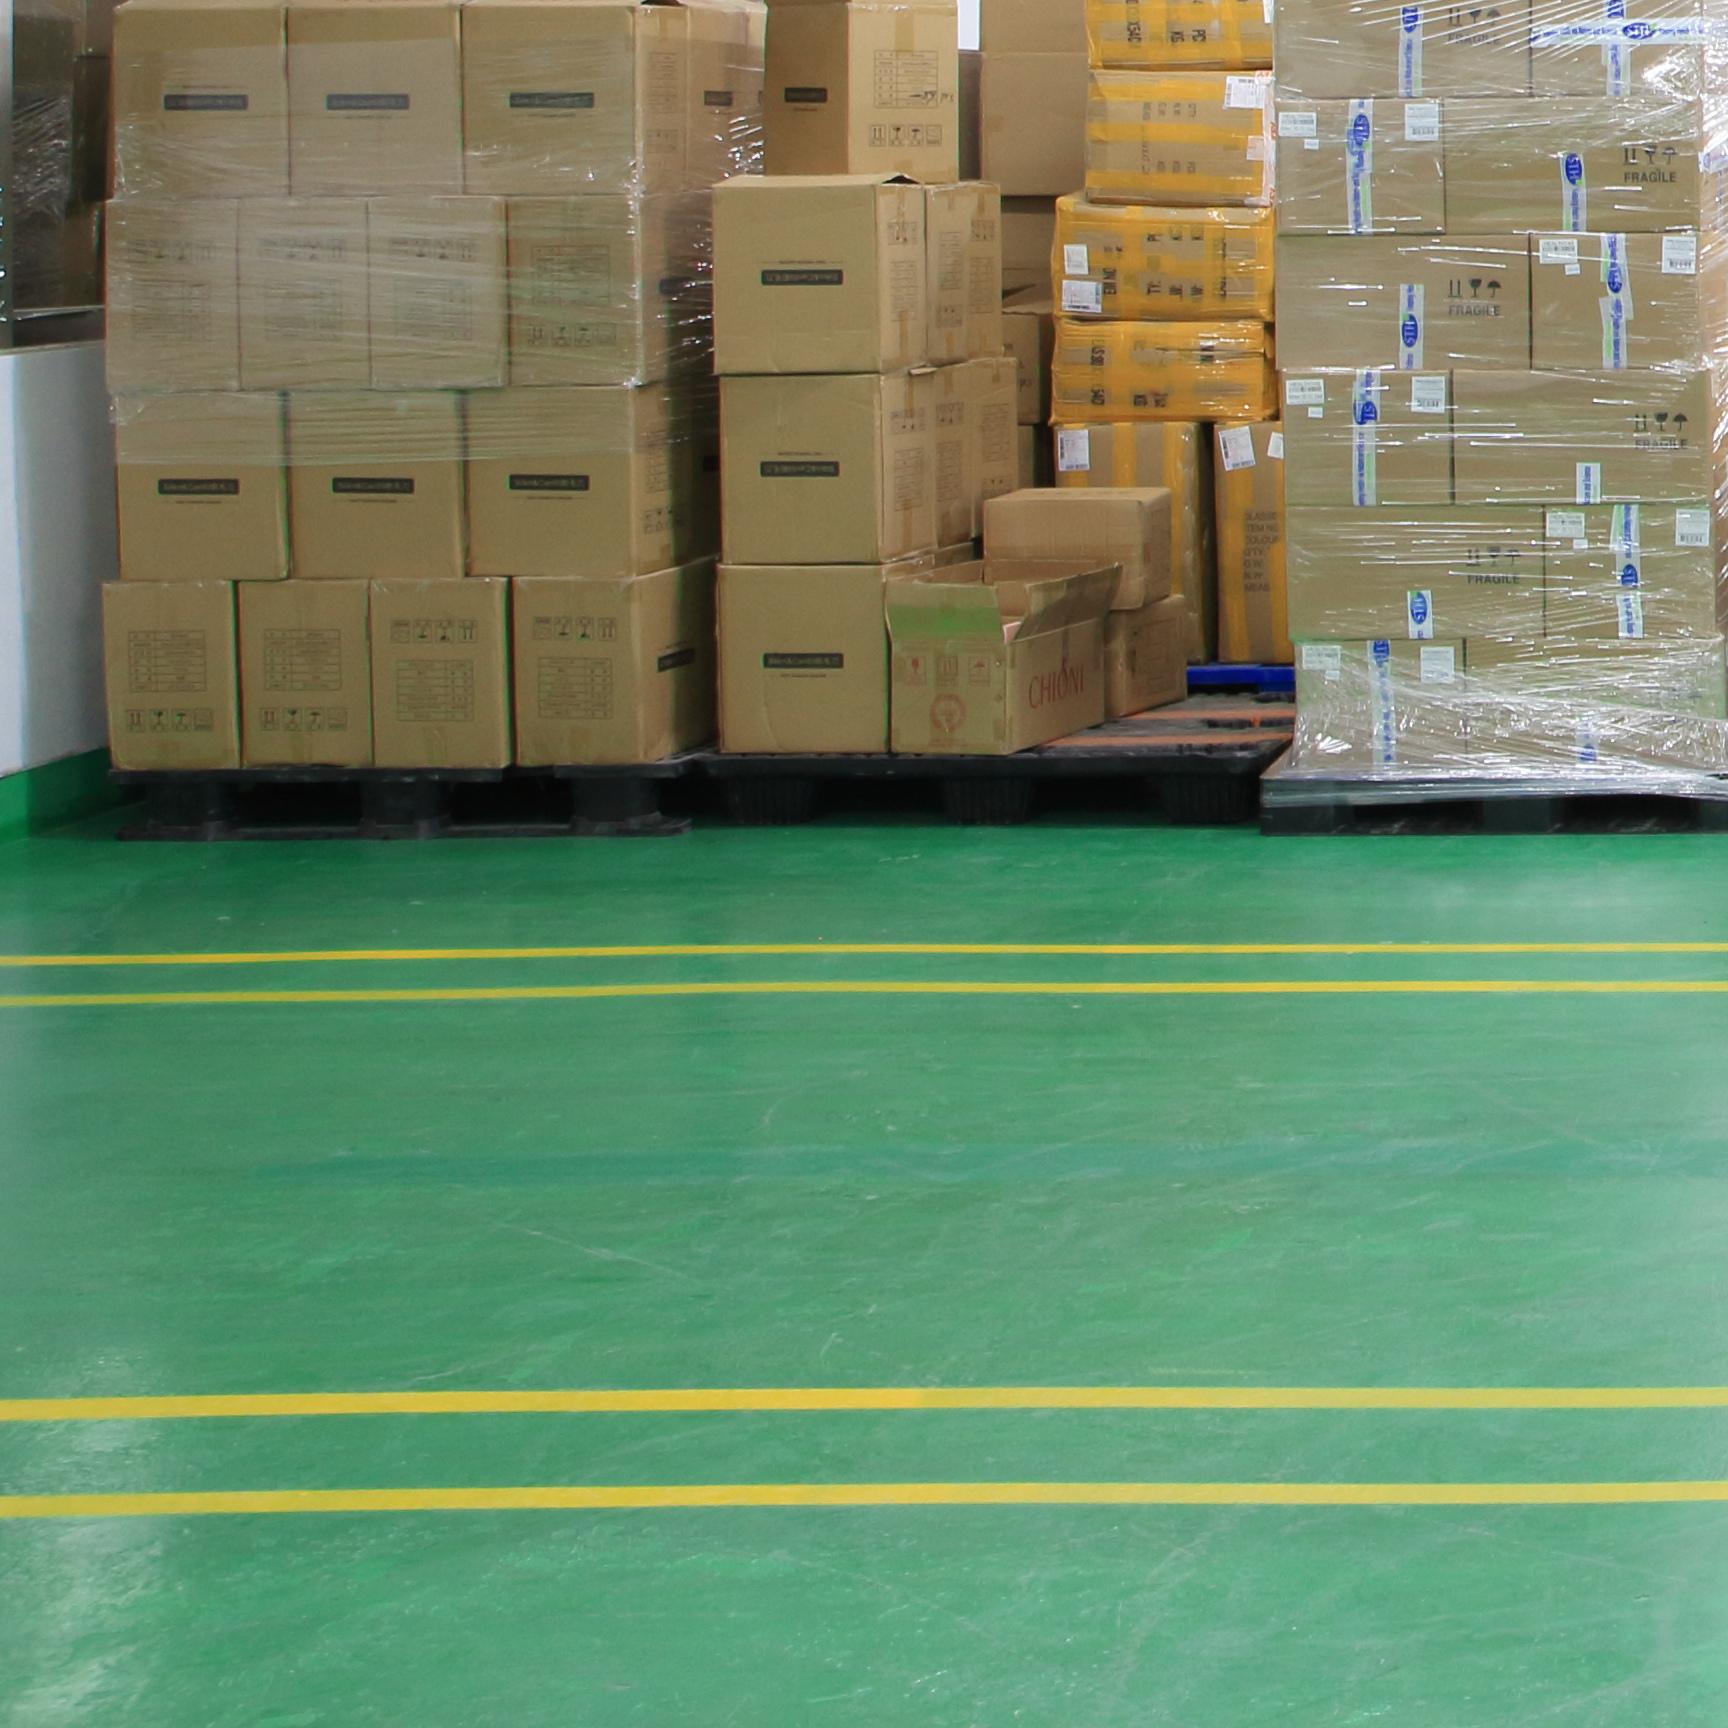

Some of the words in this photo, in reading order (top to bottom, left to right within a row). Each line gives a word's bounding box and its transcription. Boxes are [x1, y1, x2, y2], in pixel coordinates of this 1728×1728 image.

[1568, 157, 1581, 181] STH
[1624, 172, 1676, 183] FRAGILE
[1449, 305, 1501, 317] FRAGILE
[1402, 317, 1418, 345] STH
[1635, 438, 1688, 451] FRAGILE
[1467, 573, 1520, 585] FRAGILE
[1411, 595, 1428, 623] STH
